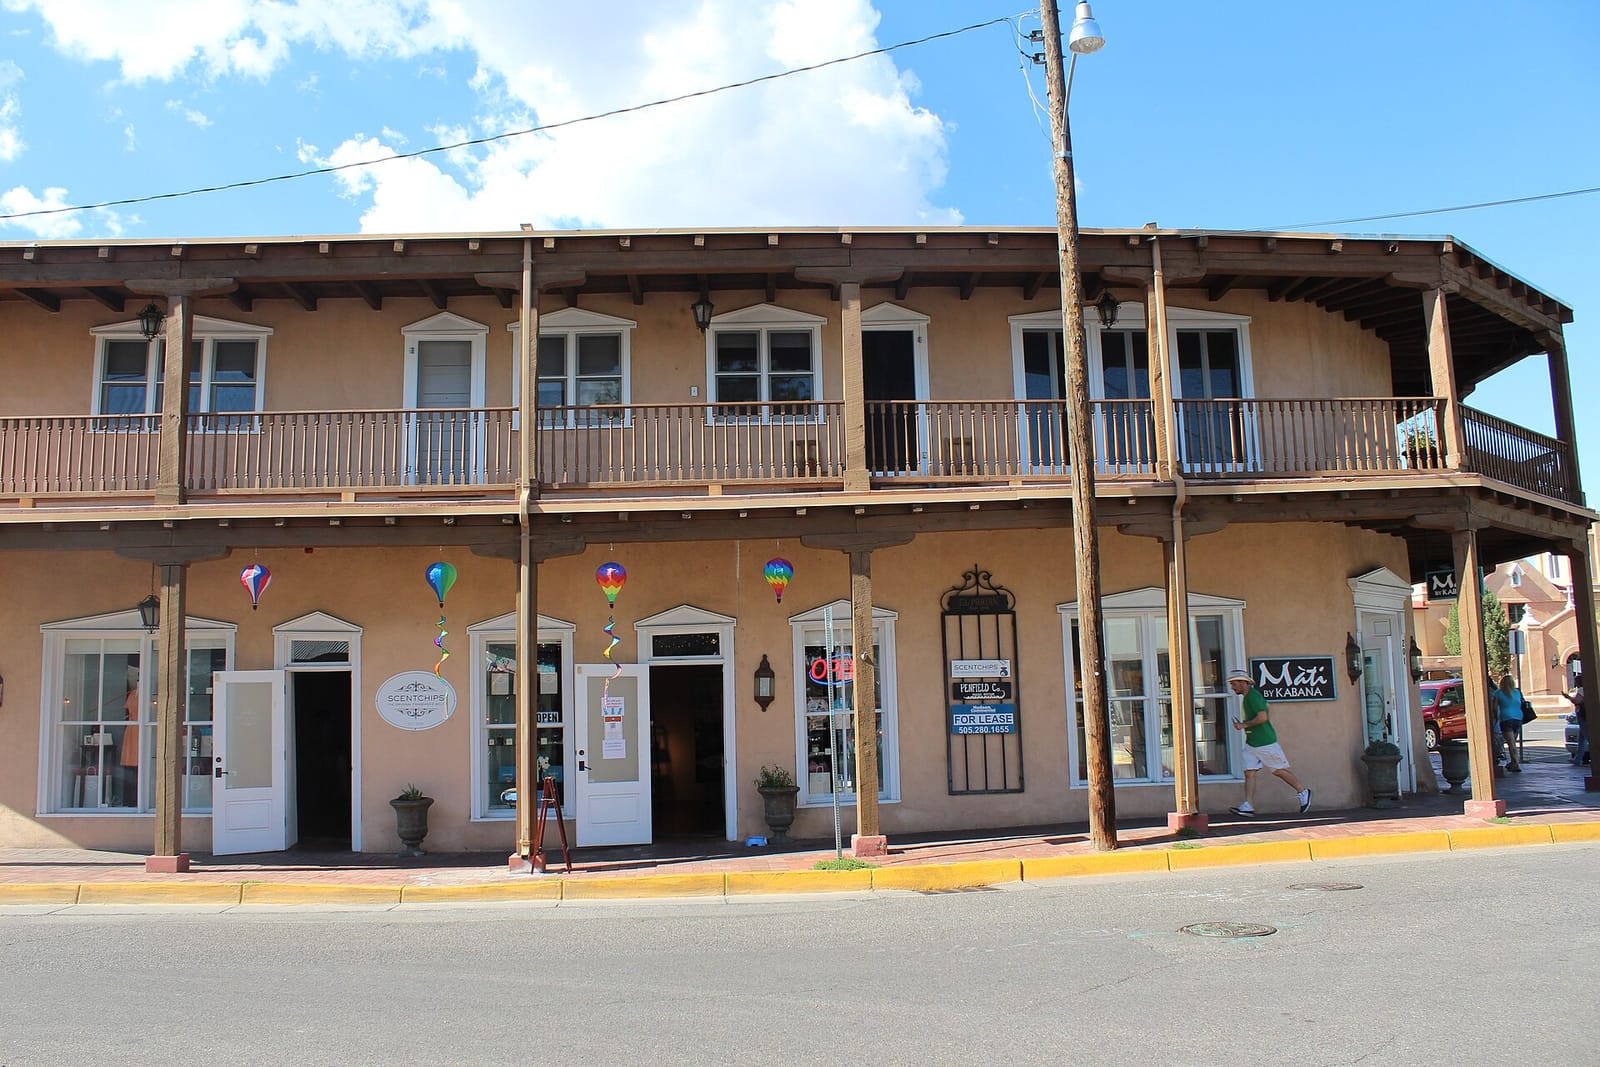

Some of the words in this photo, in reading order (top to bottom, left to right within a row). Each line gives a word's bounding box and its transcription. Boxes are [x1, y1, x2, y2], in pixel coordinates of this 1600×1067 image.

[1432, 573, 1456, 590] M
[1259, 661, 1327, 687] Màti
[960, 683, 989, 693] PENFIELD
[1263, 689, 1274, 698] BY
[1275, 687, 1323, 698] KABANA
[536, 712, 558, 723] OPEN
[954, 715, 976, 724] FOR
[978, 714, 1013, 724] LEASE
[958, 725, 1010, 734] 505.280.1655
